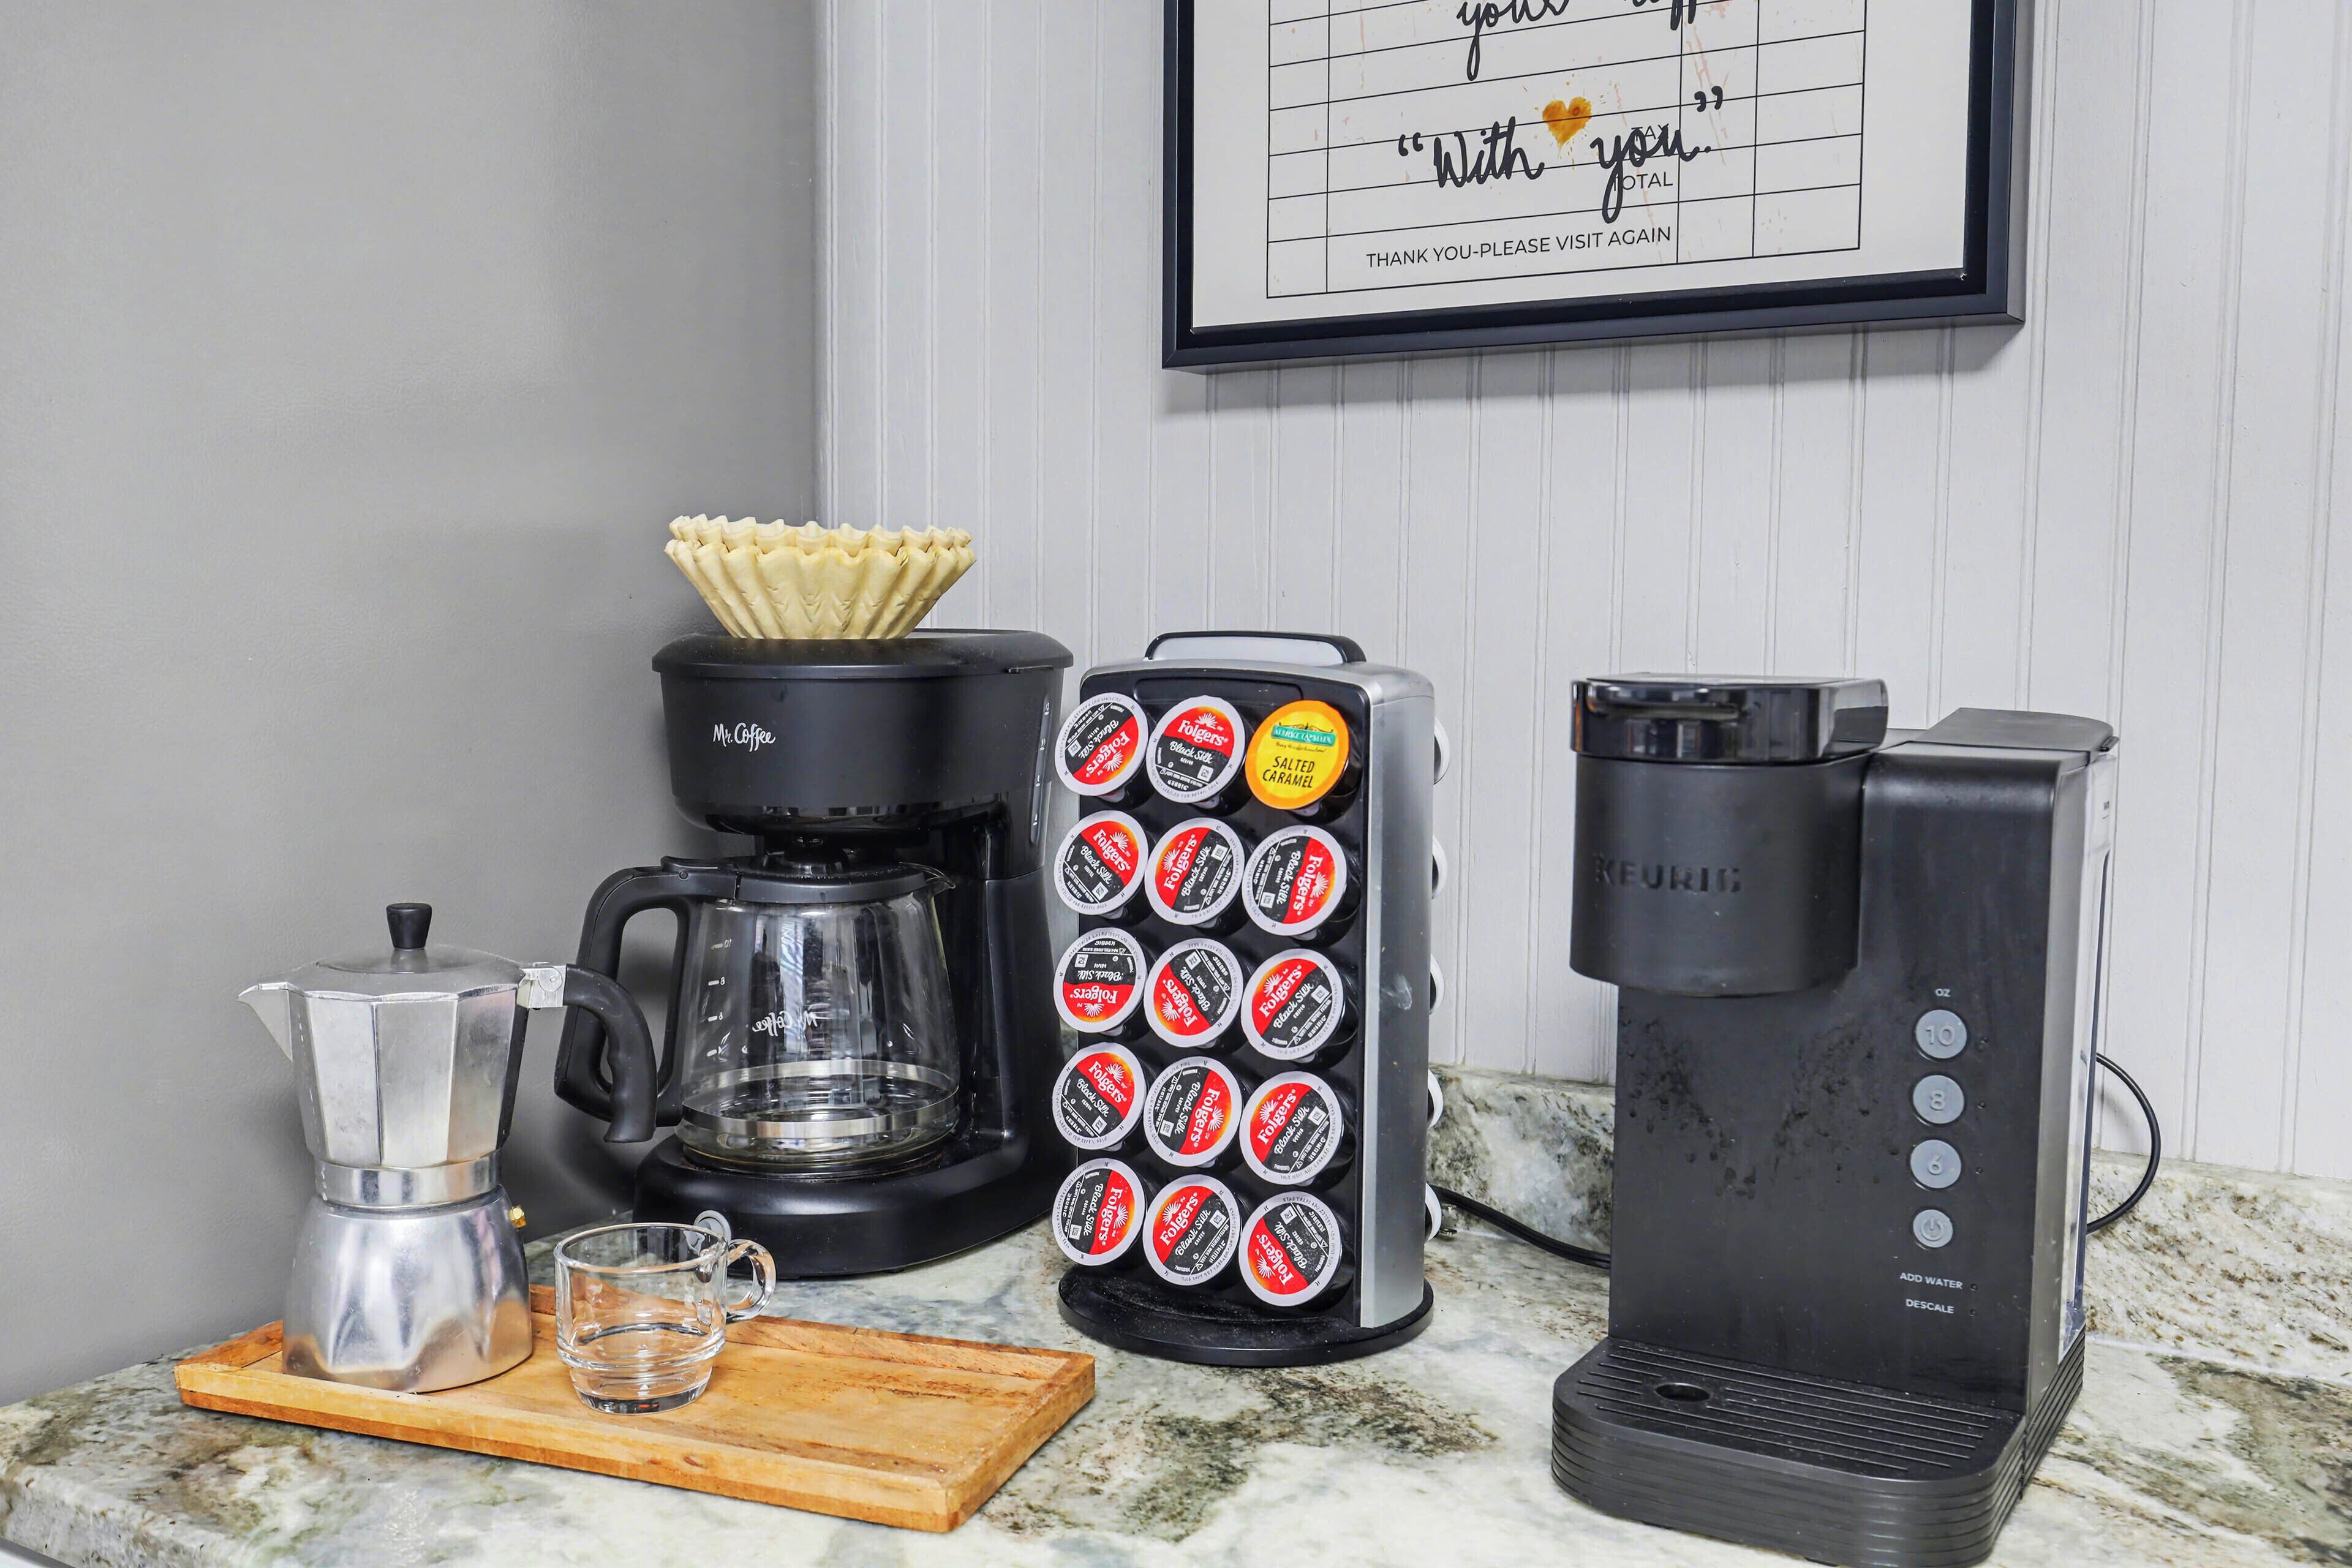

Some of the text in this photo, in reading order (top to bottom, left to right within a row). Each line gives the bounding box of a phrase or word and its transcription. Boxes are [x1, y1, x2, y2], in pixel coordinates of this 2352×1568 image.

[1366, 227, 1671, 268] THANK YOU-PLEASE VISIT AGAIN
[713, 722, 776, 752] Mr. Coffee
[1178, 720, 1224, 746] Folgers
[1085, 731, 1131, 775] Folgers
[1170, 741, 1195, 758] Black
[1194, 750, 1213, 764] Silk
[1273, 756, 1315, 773] SALTED
[1262, 769, 1313, 788] CARAMEL
[1080, 845, 1099, 870] Black
[1093, 829, 1128, 871] Folgers
[1164, 840, 1197, 891] Folgers
[1283, 851, 1301, 883] Black
[1293, 855, 1323, 911] Folgers
[1594, 854, 1740, 892] KEURIG
[1072, 986, 1118, 1004] Folgers
[1165, 979, 1197, 1028] Folgers
[1259, 969, 1303, 1018] Folgers
[1925, 1024, 1956, 1047] 10
[1077, 1078, 1096, 1104] Black
[1094, 1099, 1110, 1118] Silk
[1088, 1061, 1125, 1103] Folgers
[1182, 1082, 1201, 1114] Black
[1190, 1088, 1221, 1144] Folgers
[1929, 1090, 1945, 1111] 8
[1257, 1093, 1297, 1145] Folgers
[1273, 1125, 1296, 1155] Black
[1292, 1105, 1310, 1128] Silk
[1928, 1155, 1942, 1175] 6
[1088, 1183, 1104, 1215] Black
[1098, 1187, 1123, 1242] Folgers
[1083, 1213, 1095, 1237] Silk
[1159, 1197, 1199, 1246] Folgers
[1259, 1234, 1294, 1286] Folgers
[1900, 1272, 1963, 1289] ADD WATER
[1905, 1298, 1954, 1314] DESCALE
